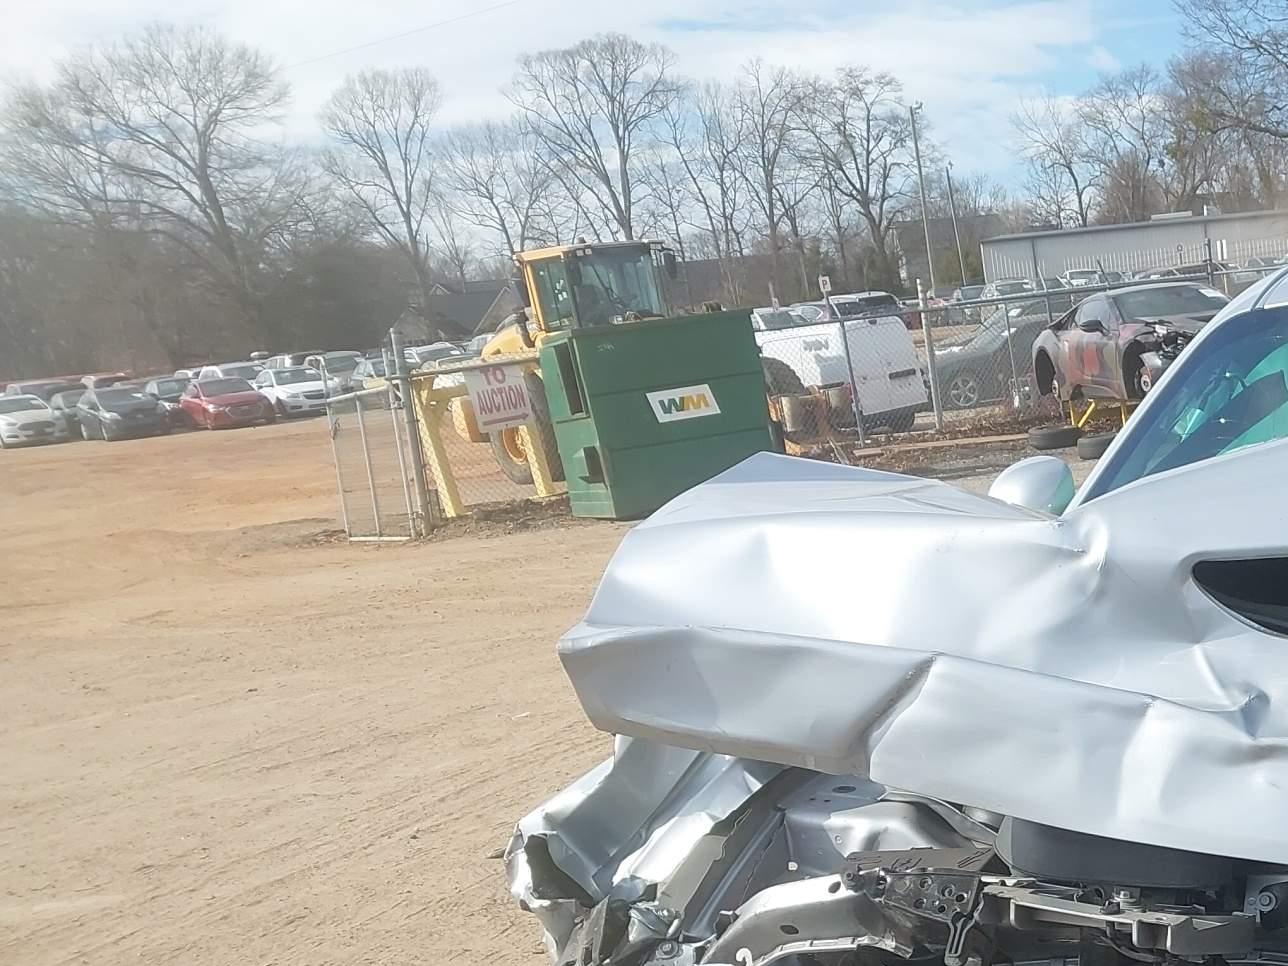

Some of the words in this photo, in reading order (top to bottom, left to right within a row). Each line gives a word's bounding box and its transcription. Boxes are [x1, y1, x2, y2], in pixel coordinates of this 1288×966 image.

[480, 366, 506, 385] TO
[477, 384, 526, 415] AUCTION
[658, 393, 710, 414] WM
